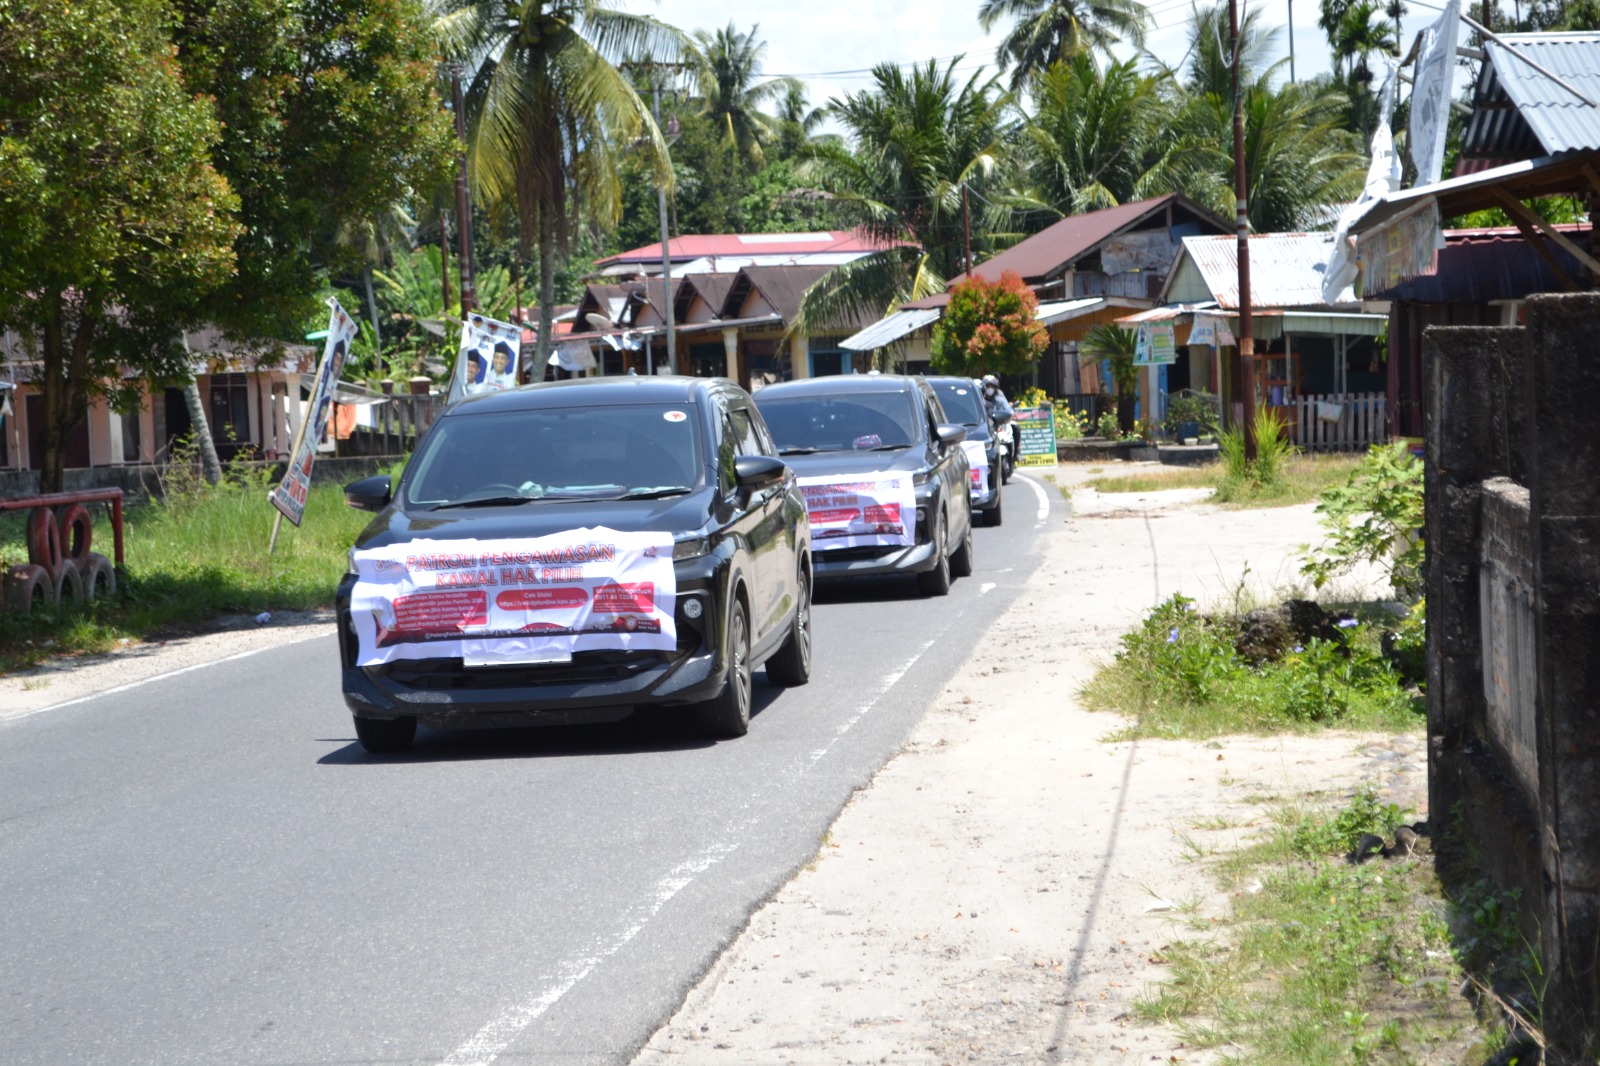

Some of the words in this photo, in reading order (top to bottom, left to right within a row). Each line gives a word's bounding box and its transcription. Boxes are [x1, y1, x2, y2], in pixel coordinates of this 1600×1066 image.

[800, 481, 877, 496] ENGAWASAN
[406, 553, 475, 572] PATROLI
[480, 544, 615, 567] PENGAWASAN
[436, 570, 498, 590] KAWAL
[501, 567, 540, 586] HAK
[541, 566, 584, 584] PILIH
